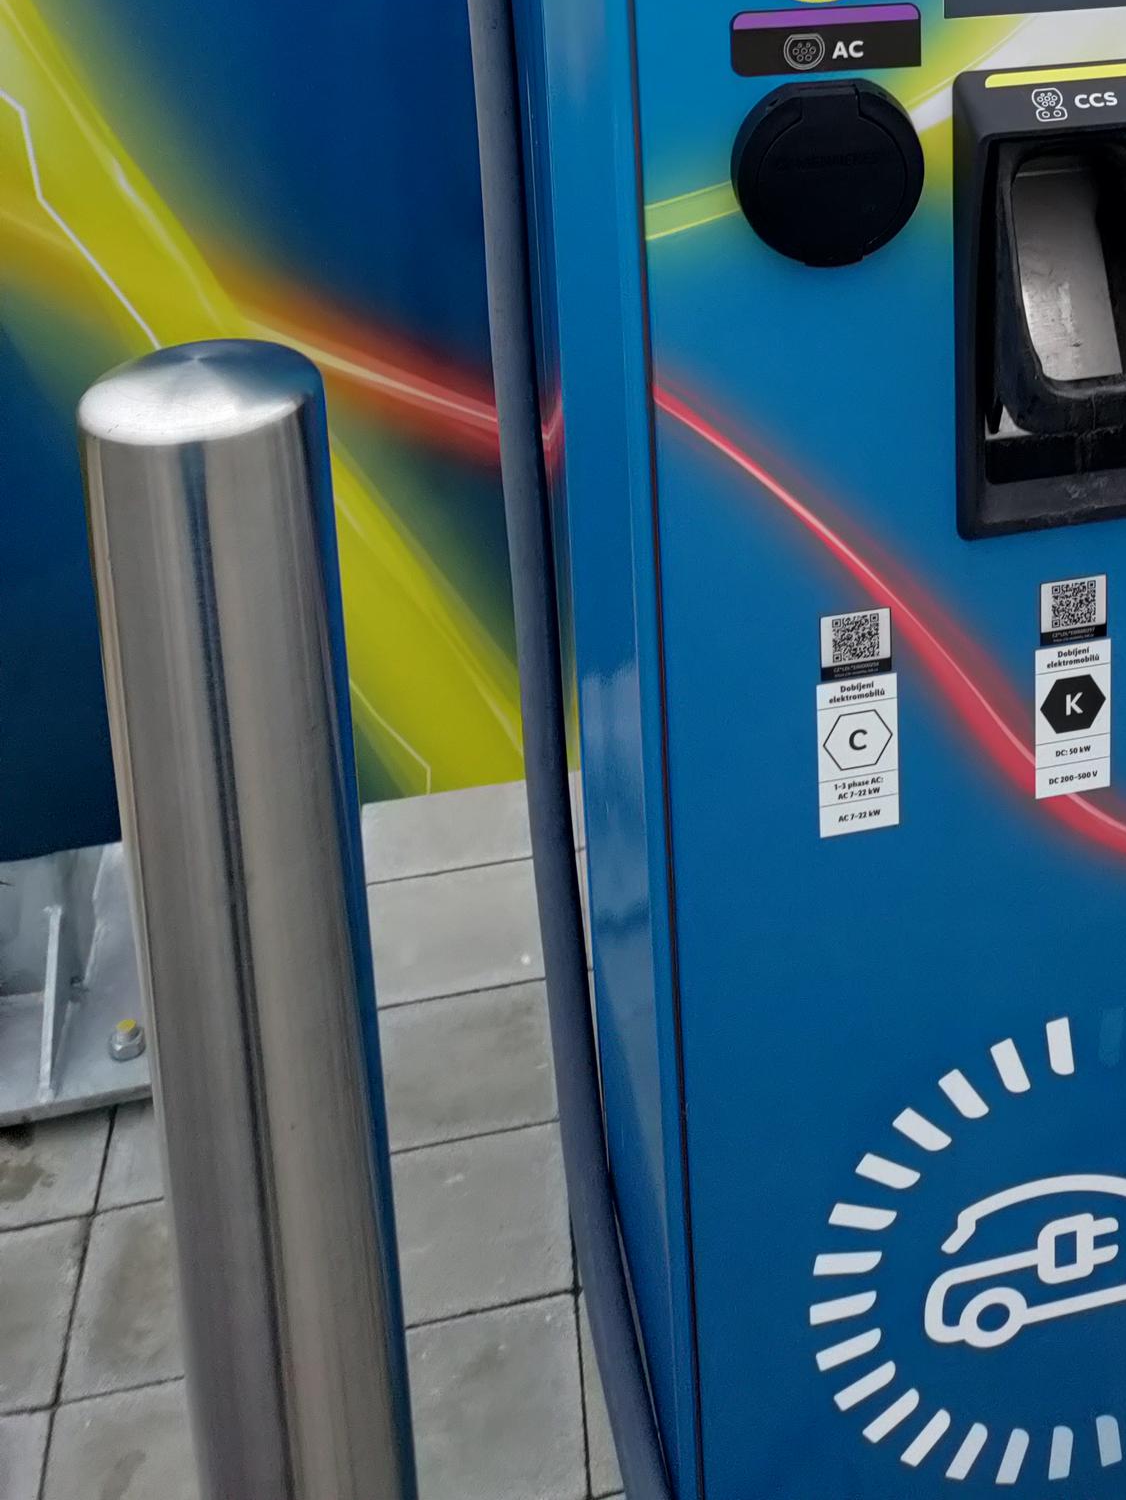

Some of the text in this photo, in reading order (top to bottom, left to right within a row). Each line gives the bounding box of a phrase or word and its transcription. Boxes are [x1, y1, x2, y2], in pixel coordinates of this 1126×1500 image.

[832, 41, 864, 59] AC
[1074, 91, 1118, 109] CCS
[1057, 646, 1090, 658] Dobíjení
[1046, 654, 1100, 669] elektromobilů
[840, 680, 874, 694] Dobíjení
[829, 689, 885, 705] elektromobilů
[1065, 692, 1084, 716] K
[848, 728, 868, 751] C
[1055, 745, 1091, 757] DC: 50 kW
[847, 780, 870, 792] phase
[871, 776, 884, 786] AC:
[1049, 777, 1059, 786] DC
[1092, 770, 1098, 778] V
[837, 791, 849, 800] AC
[868, 786, 880, 796] kW
[838, 813, 849, 823] AC
[868, 809, 881, 818] kW
